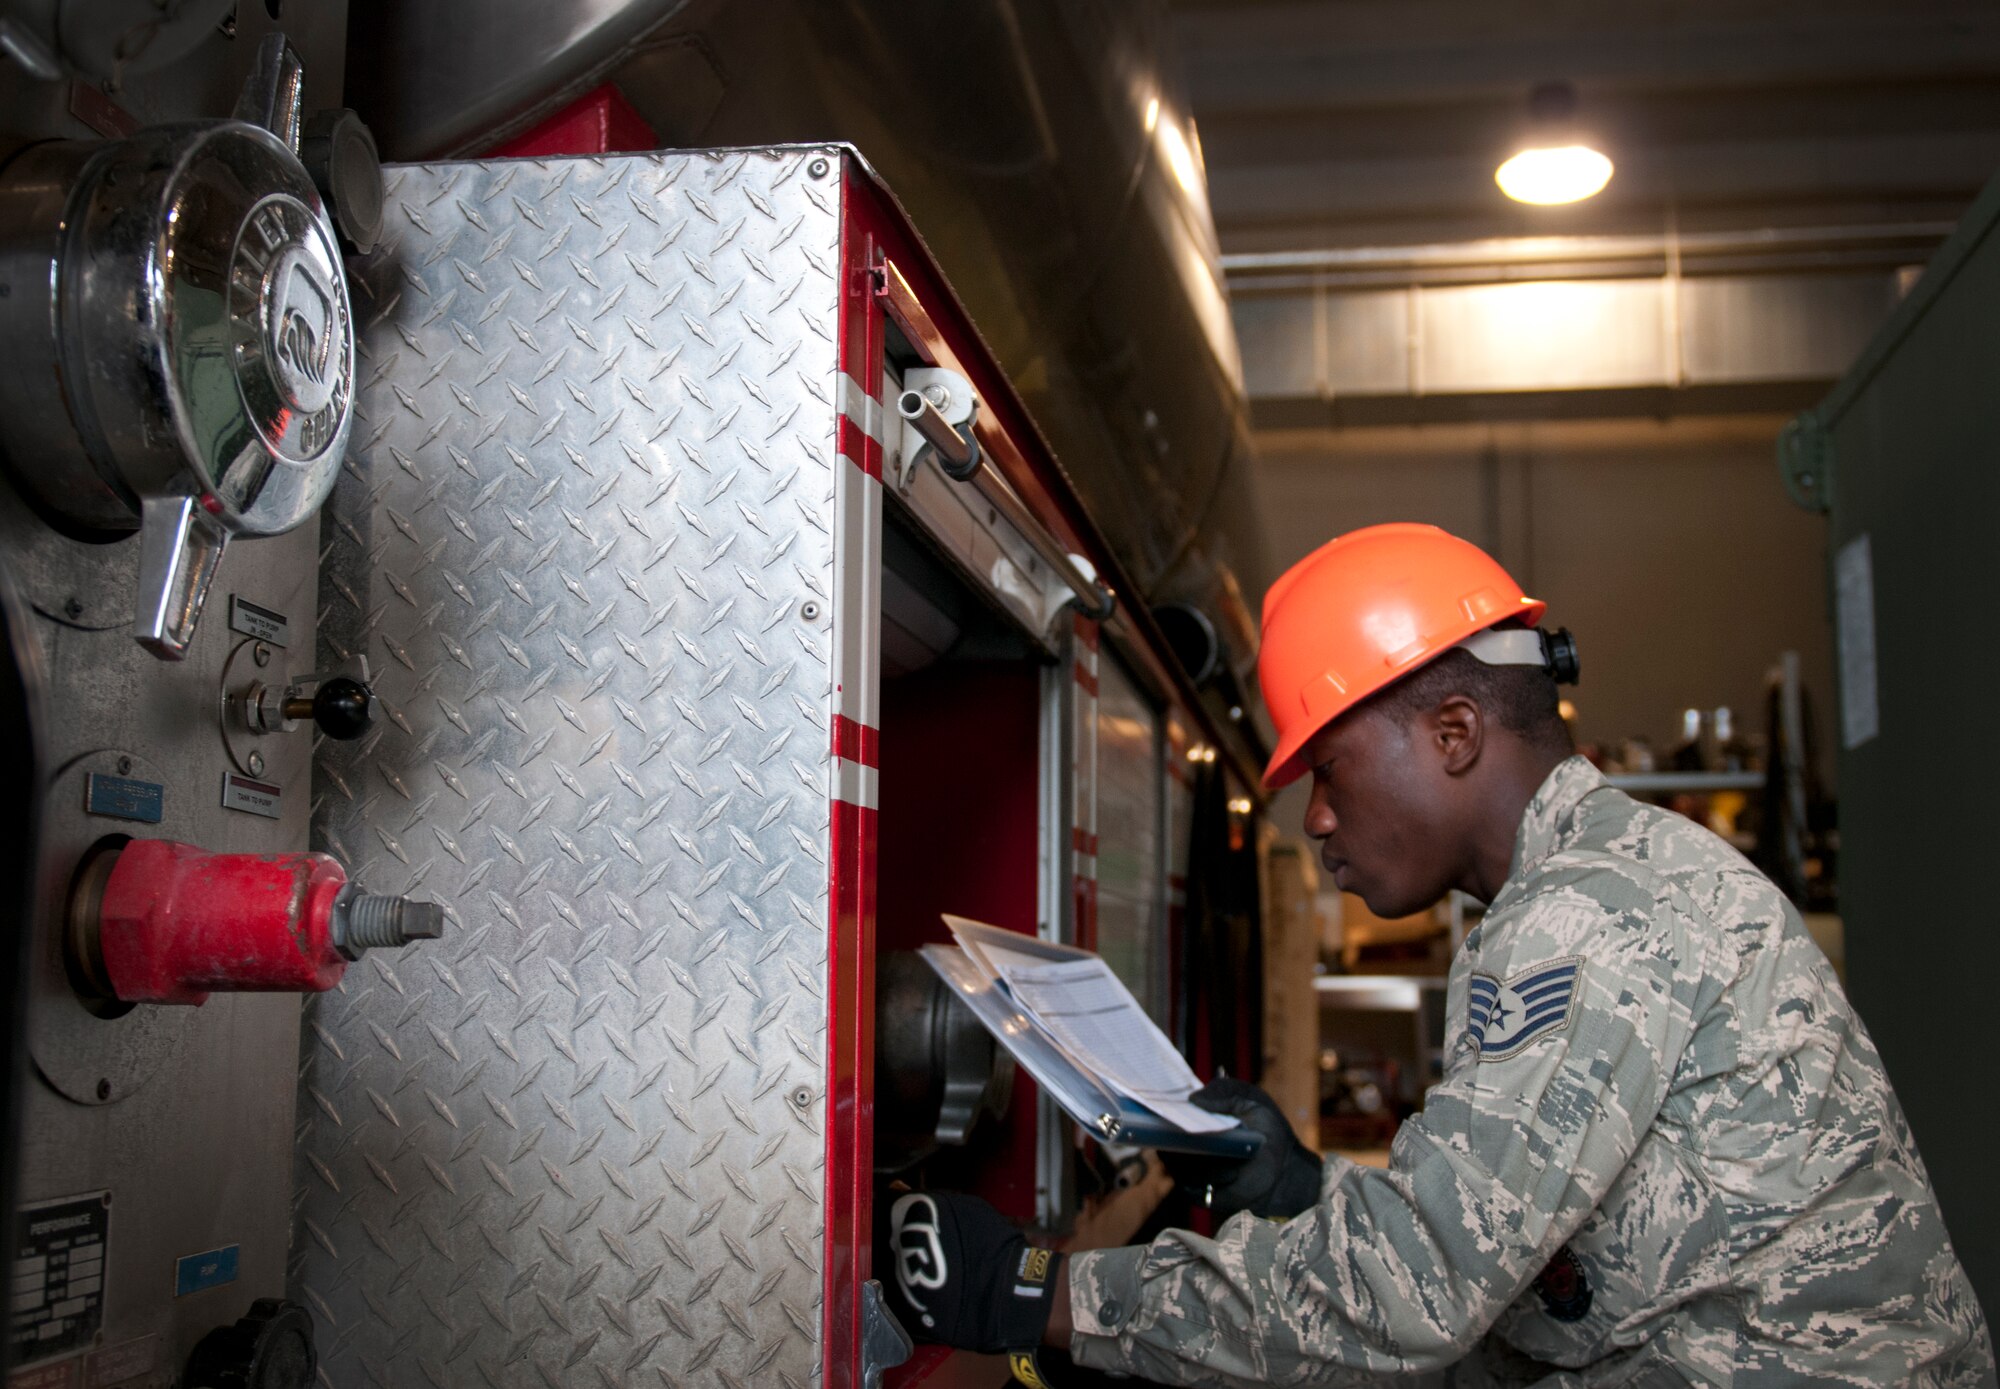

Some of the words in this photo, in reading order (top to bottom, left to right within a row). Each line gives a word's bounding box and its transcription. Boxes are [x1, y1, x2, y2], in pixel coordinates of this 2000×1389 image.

[245, 614, 258, 624] TANK
[266, 622, 280, 632] PUMP
[237, 793, 251, 802] TANK
[258, 798, 273, 807] PUMP
[30, 1213, 91, 1236] PERFORMANCE
